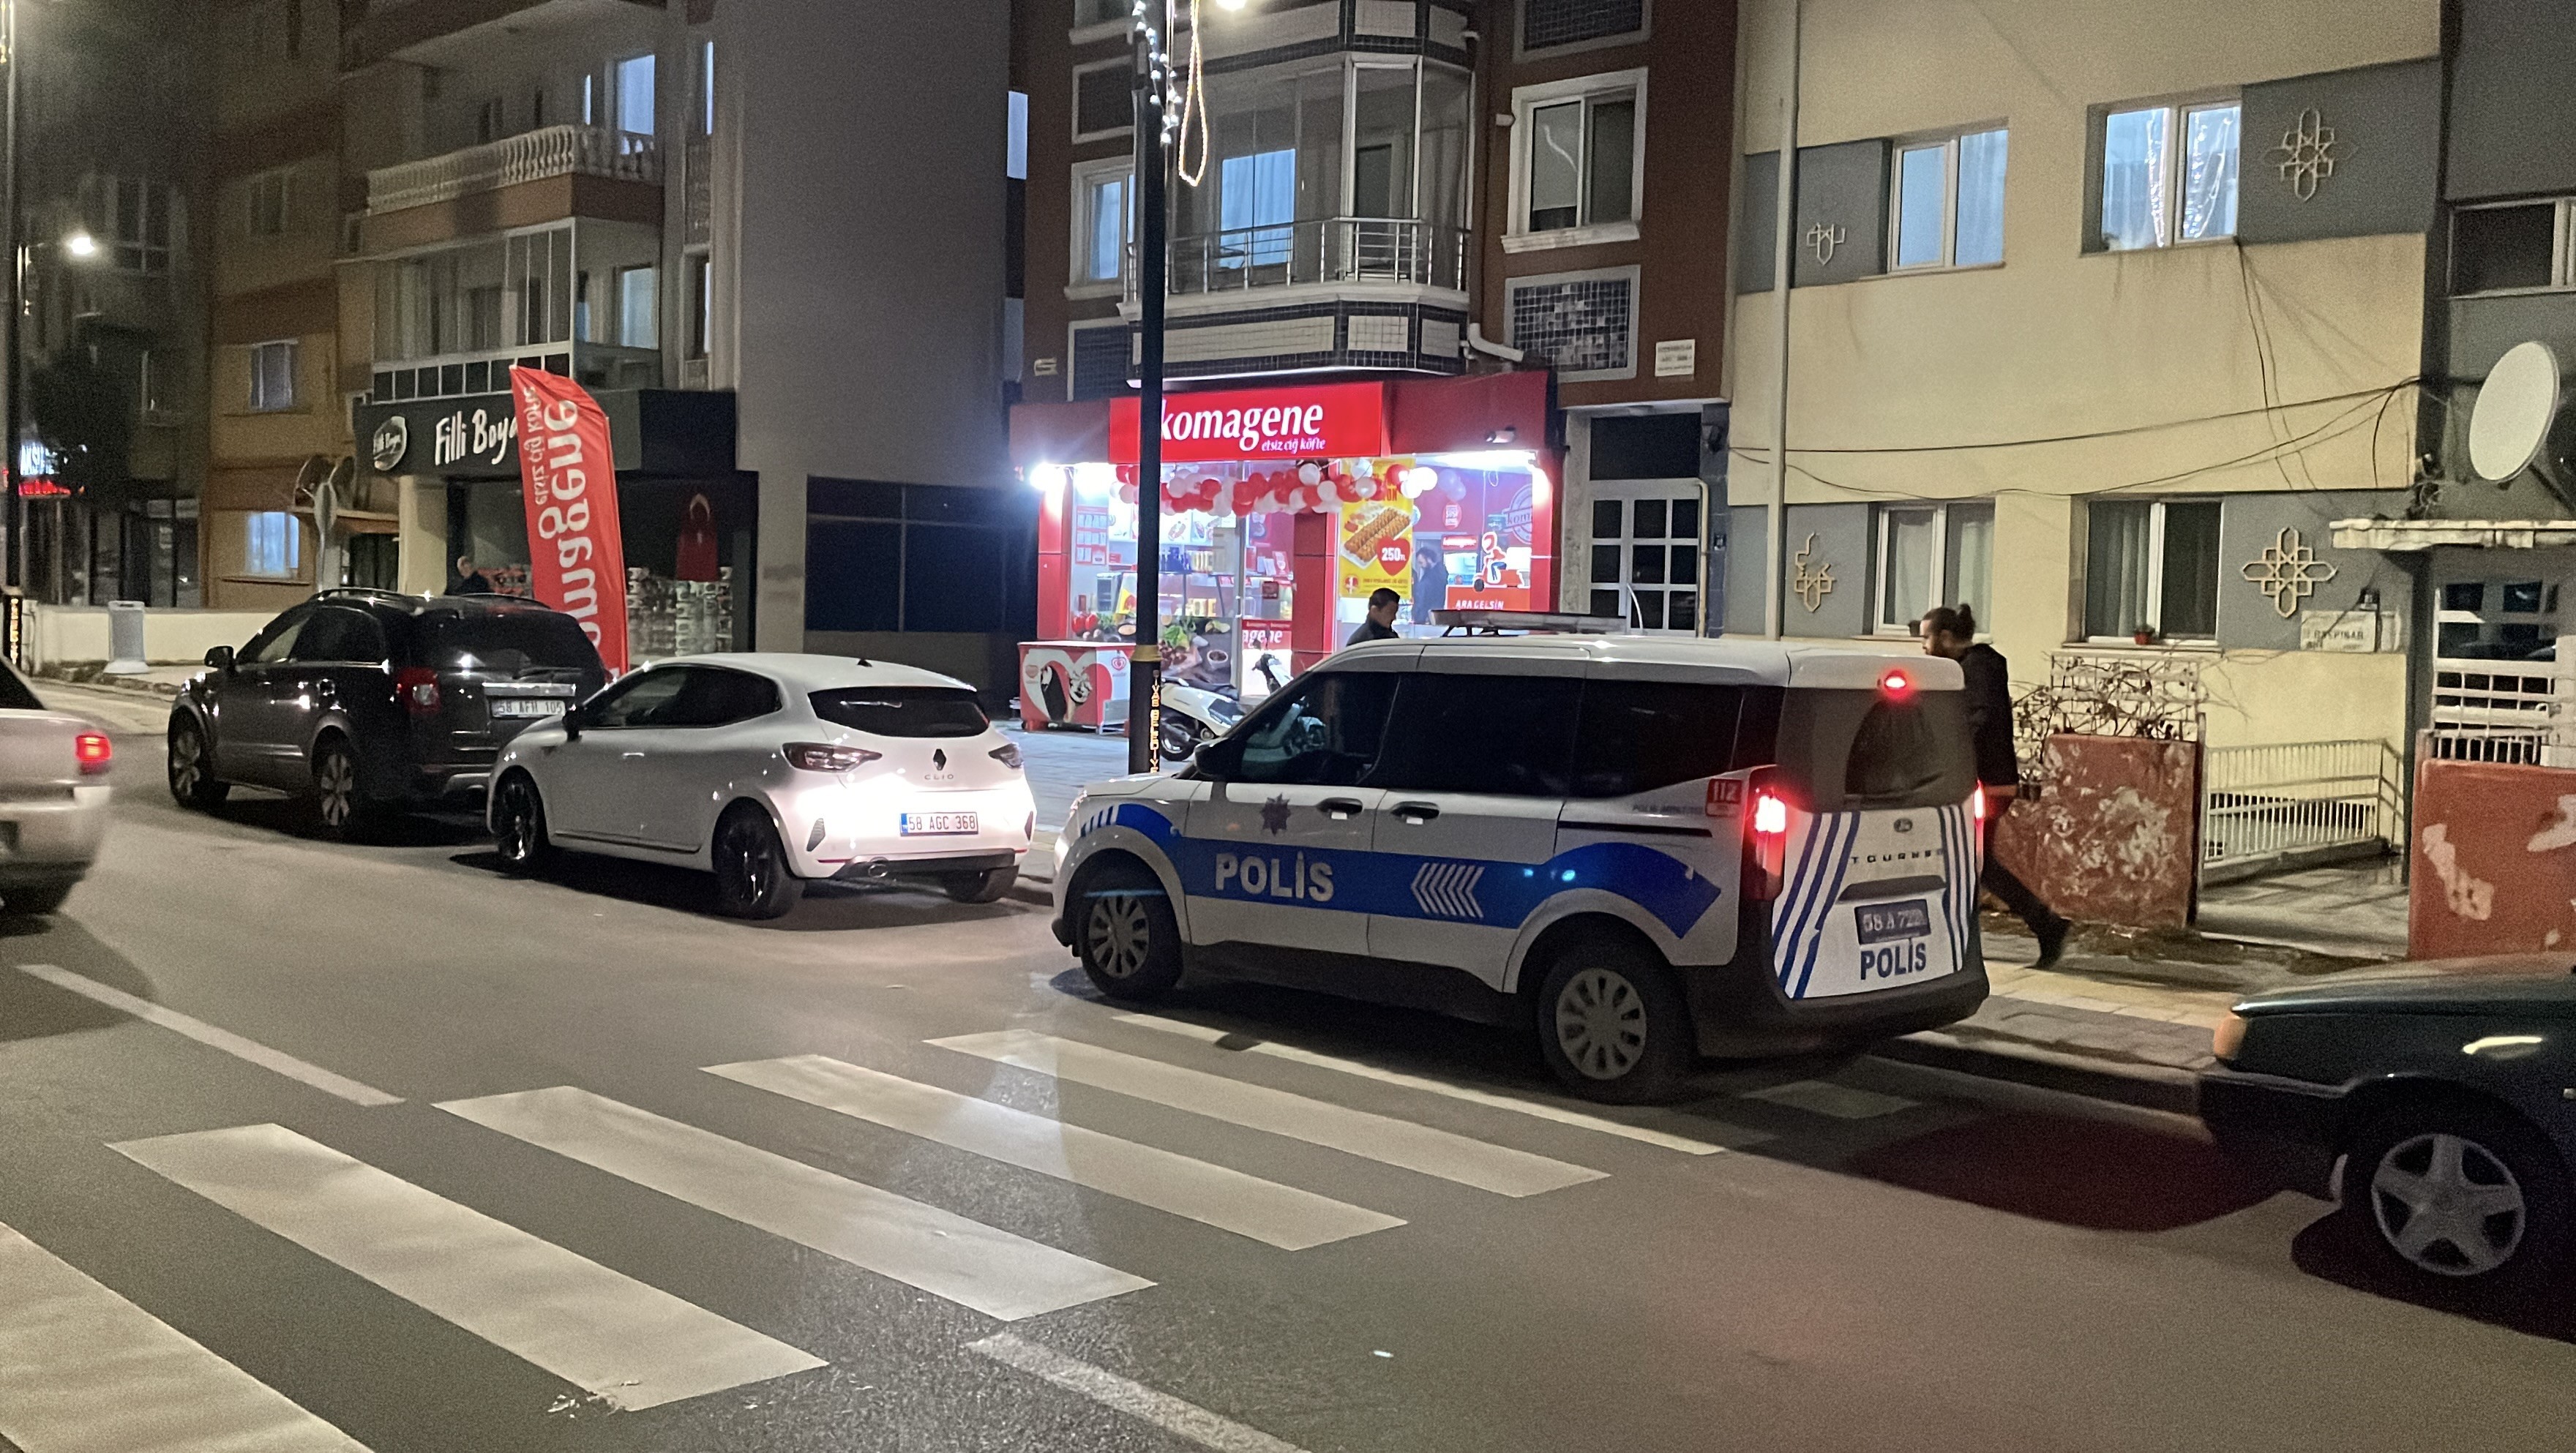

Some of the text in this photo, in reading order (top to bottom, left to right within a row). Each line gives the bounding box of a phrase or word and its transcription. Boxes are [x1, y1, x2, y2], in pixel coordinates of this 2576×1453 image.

[435, 410, 467, 466] Filli
[1160, 399, 1323, 451] komagene
[1713, 781, 1738, 802] 112
[908, 815, 976, 830] 58 AGC 368
[1215, 851, 1334, 902] POLİS
